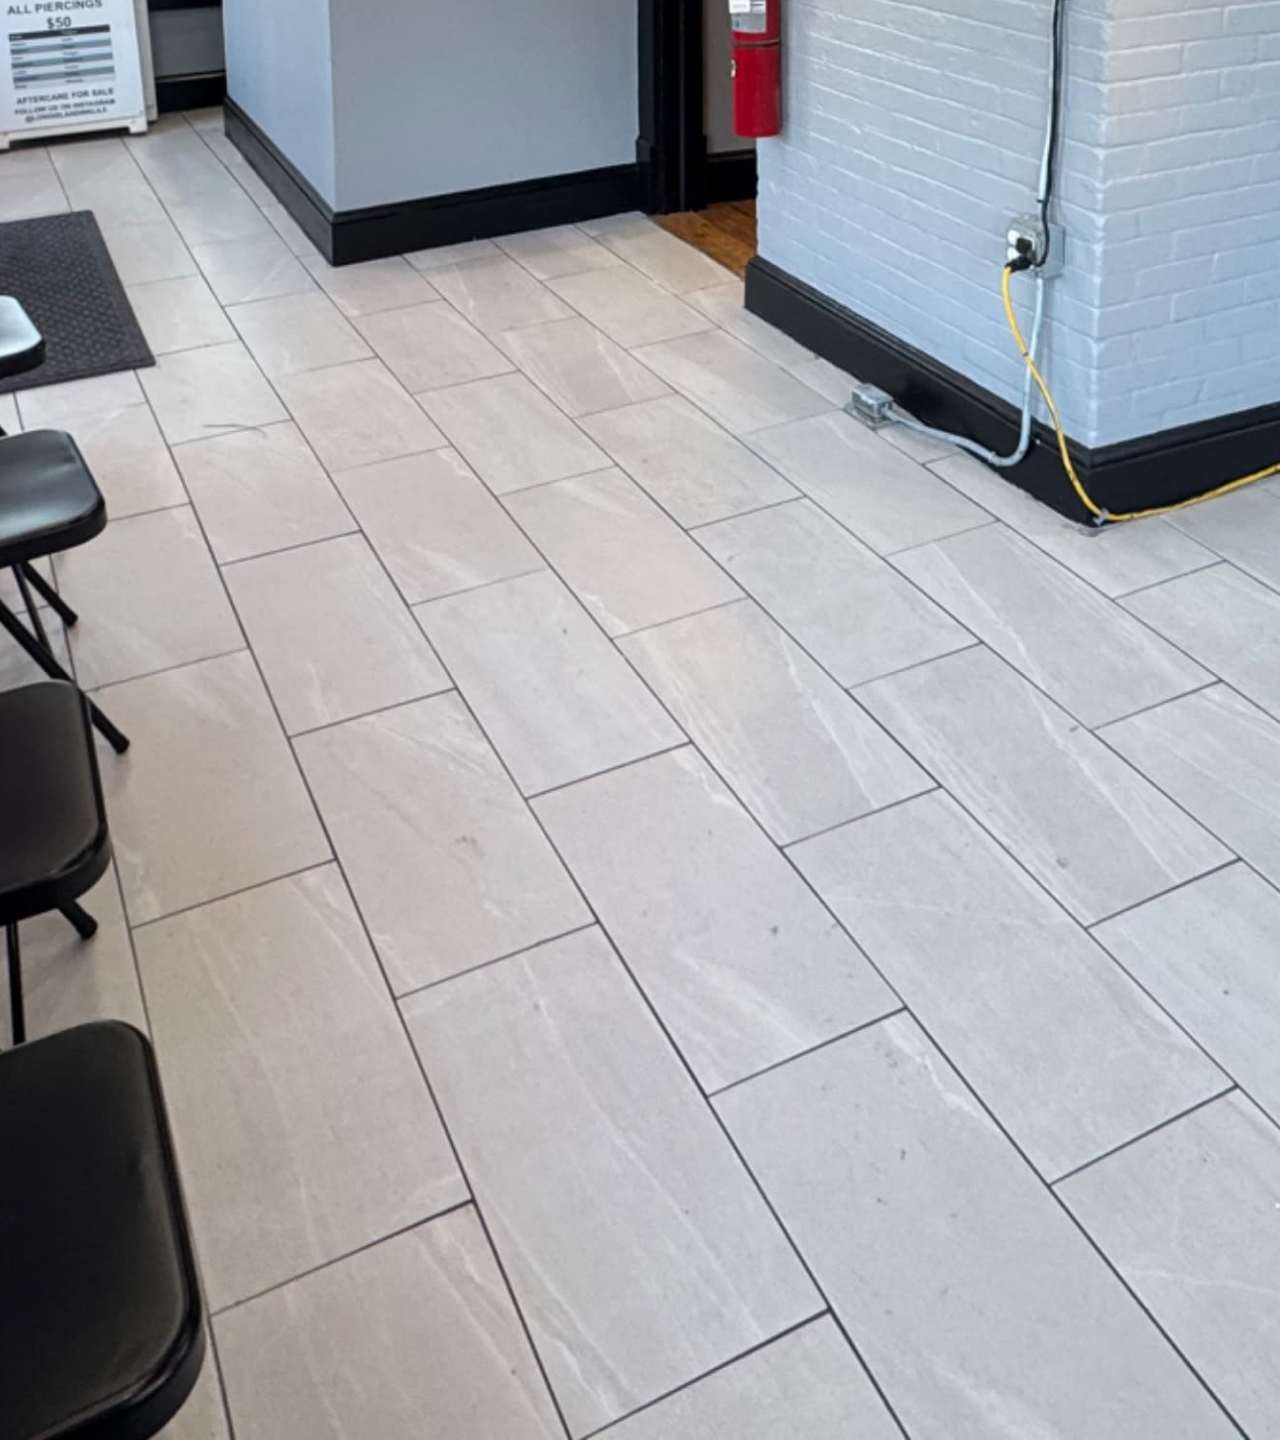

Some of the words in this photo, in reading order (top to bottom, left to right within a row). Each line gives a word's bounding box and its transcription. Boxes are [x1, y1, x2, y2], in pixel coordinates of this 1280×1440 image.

[7, 4, 31, 15] ALL
[46, 16, 72, 29] $50
[71, 89, 90, 99] FOR
[92, 87, 114, 97] SALE
